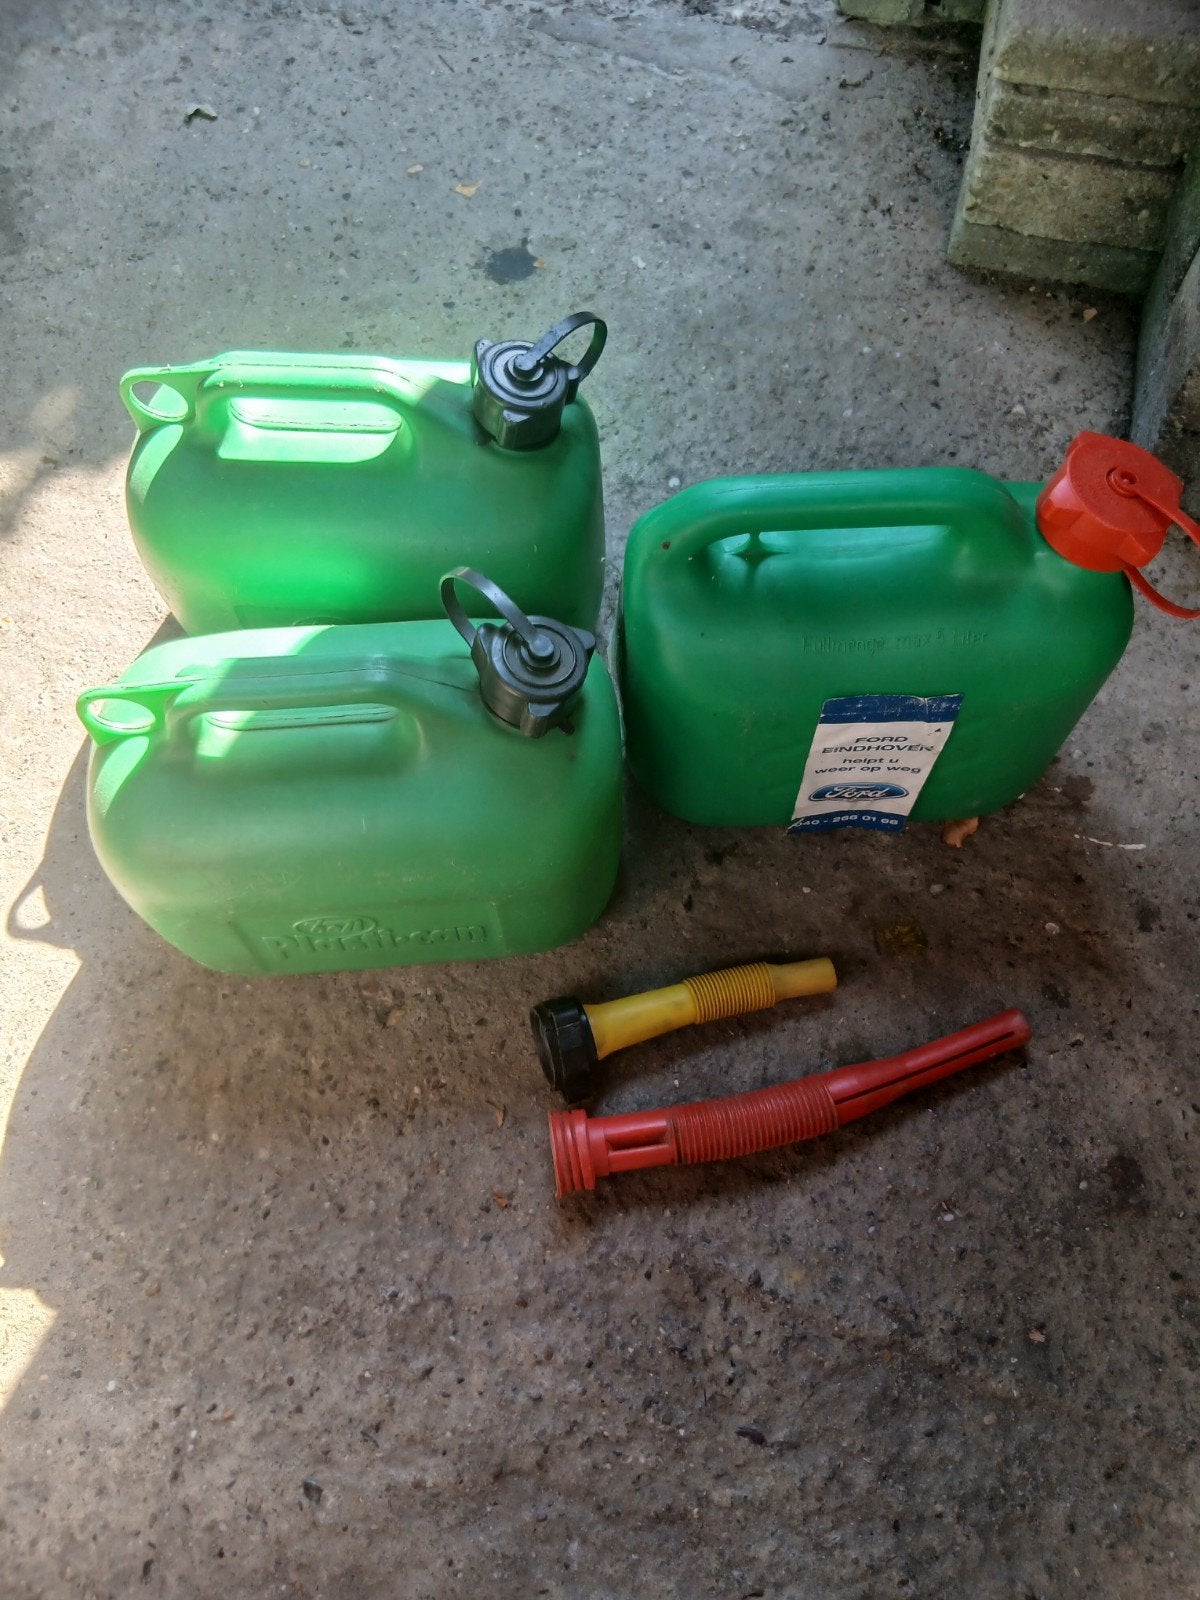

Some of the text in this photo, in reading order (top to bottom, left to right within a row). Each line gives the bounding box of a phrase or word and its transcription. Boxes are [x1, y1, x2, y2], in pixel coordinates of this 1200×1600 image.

[821, 744, 934, 753] EINDHOVEN
[814, 766, 855, 774] weer
[886, 766, 921, 774] weg
[825, 785, 889, 798] Ford
